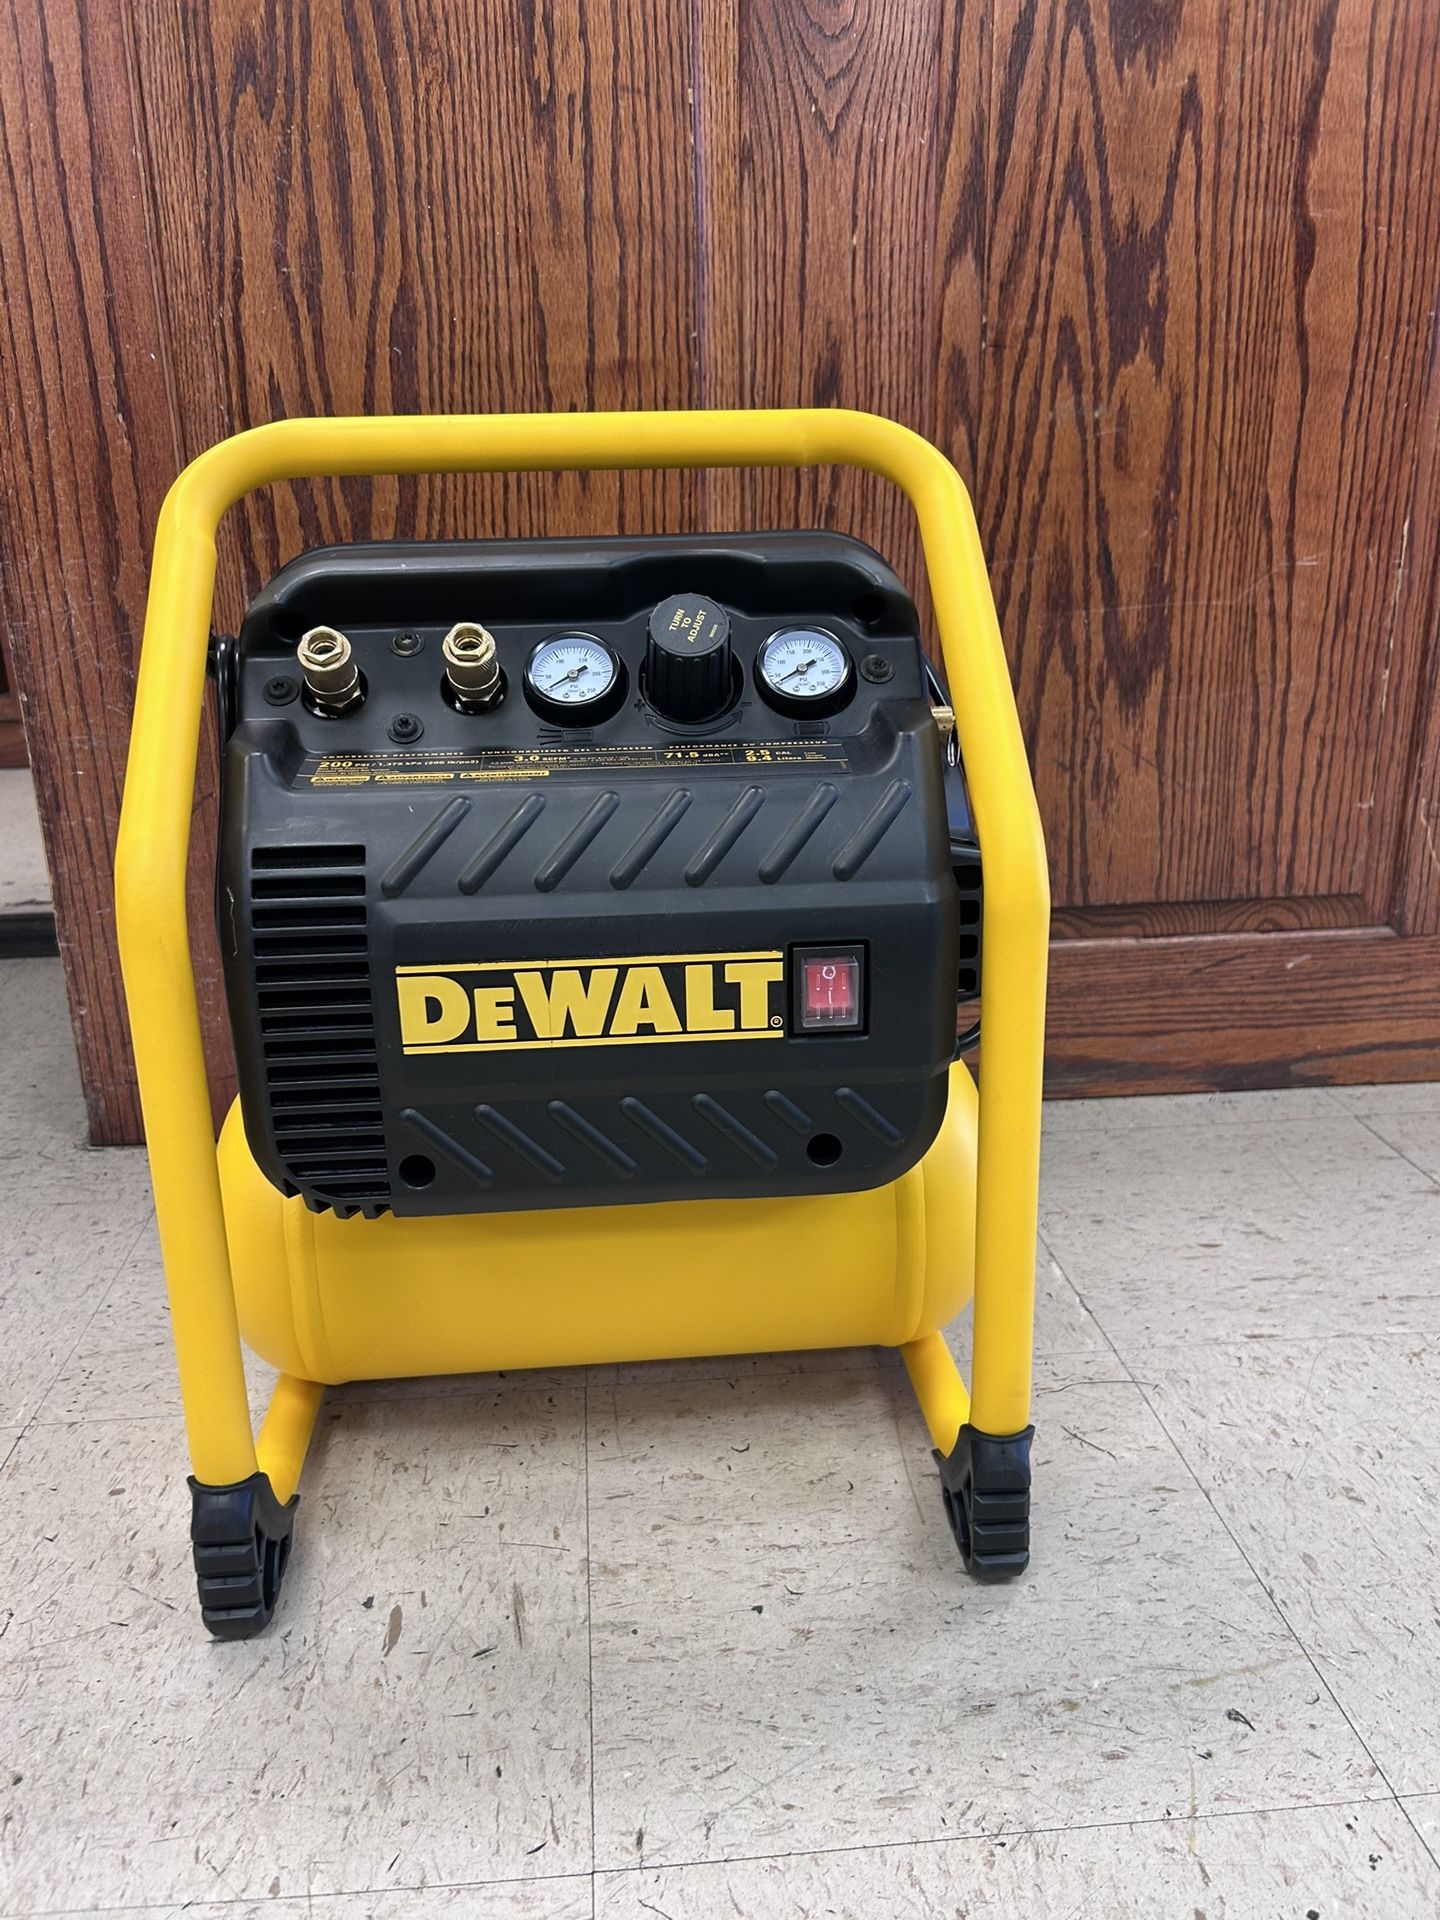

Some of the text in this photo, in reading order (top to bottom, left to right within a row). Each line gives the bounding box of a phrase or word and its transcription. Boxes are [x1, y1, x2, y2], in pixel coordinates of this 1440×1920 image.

[668, 608, 686, 632] TURN
[680, 616, 692, 629] TO
[687, 608, 707, 643] ADJUST
[664, 751, 700, 759] 71.5
